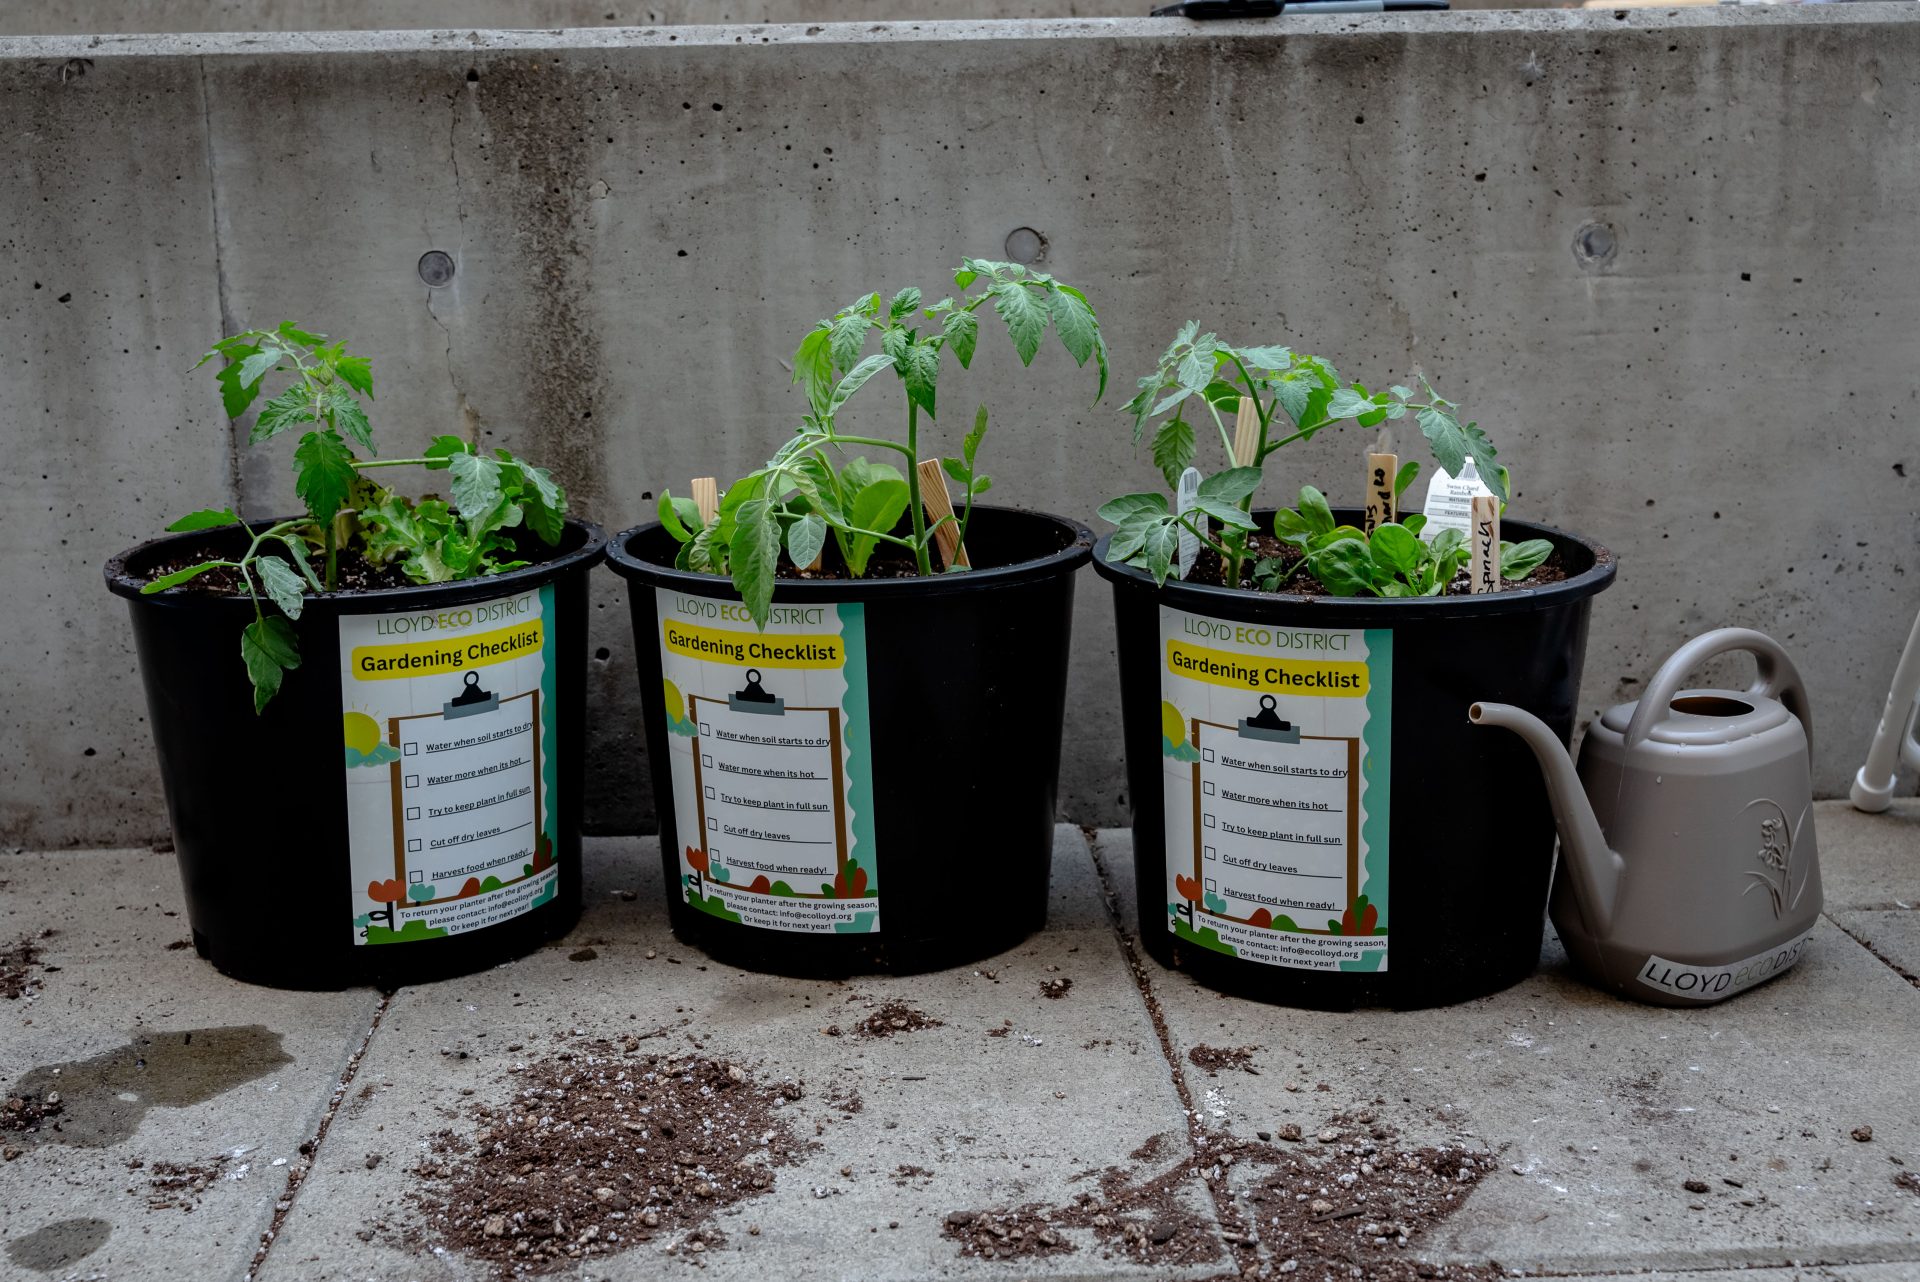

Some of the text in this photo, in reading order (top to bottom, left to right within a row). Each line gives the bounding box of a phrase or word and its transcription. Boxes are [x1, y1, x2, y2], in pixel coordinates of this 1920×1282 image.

[378, 596, 531, 635] LLOYD ECO DISTRICT
[676, 597, 824, 624] LLOYD ECO ISTRICT
[669, 630, 836, 660] Gardening Checklist
[1185, 617, 1350, 650] LLOYD ECO DISTRICT
[361, 630, 538, 671] Gardening Checklist
[1173, 652, 1360, 688] Gardening Checklist
[426, 722, 534, 751] Water when soil starts to dry
[716, 729, 738, 739] Water
[740, 734, 760, 742] when
[762, 735, 777, 743] soil
[778, 737, 803, 745] starts
[816, 738, 830, 747] dry
[427, 776, 452, 784] Water
[455, 770, 476, 779] more
[478, 765, 498, 775] when
[510, 758, 521, 766] hot
[719, 762, 740, 771] Water
[742, 767, 761, 775] more
[1222, 756, 1246, 767] Water
[1248, 762, 1271, 771] when
[1273, 764, 1288, 773] soil
[1291, 767, 1317, 775] starts
[1332, 768, 1348, 777] dry
[428, 808, 442, 816] Try
[456, 802, 474, 811] keep
[476, 797, 496, 808] plant
[506, 790, 518, 798] full
[519, 786, 531, 794] sun
[721, 793, 732, 802] Try
[744, 797, 762, 807] keep
[764, 800, 785, 809] plant
[796, 802, 810, 810] full
[1222, 789, 1246, 800] Water
[1248, 796, 1270, 805] more
[1272, 799, 1296, 808] when
[1299, 801, 1309, 809] its
[431, 827, 500, 847] Cut off dry leaves
[724, 825, 790, 840] Cut off dry leaves
[1222, 822, 1235, 832] Try
[1237, 826, 1245, 834] to
[1248, 828, 1268, 838] keep
[1270, 831, 1293, 841] plant
[1306, 835, 1322, 843] full
[432, 869, 464, 878] Harvest
[486, 857, 505, 866] when
[508, 848, 528, 860] ready!
[727, 856, 827, 874] Harvest food when ready!
[1223, 855, 1297, 873] Cut off dry leaves
[413, 908, 438, 917] return
[440, 904, 458, 914] your
[460, 898, 486, 910] planter
[488, 893, 503, 901] after
[505, 888, 516, 897] the
[517, 879, 539, 893] growing
[429, 887, 543, 926] please contact: info@ecolloyd.org
[706, 884, 714, 892] To
[714, 888, 732, 898] return
[734, 893, 749, 903] your
[751, 896, 776, 908] planter
[798, 901, 812, 909] the
[814, 902, 845, 910] growing
[1224, 887, 1334, 910] Harvest food when ready!
[462, 920, 480, 930] keep
[488, 914, 498, 922] for
[499, 910, 513, 920] next
[515, 903, 529, 914] year!
[727, 901, 851, 921] please contact: info@ecolloyd.org
[754, 917, 771, 927] keep
[772, 919, 778, 927] it
[780, 920, 790, 928] for
[1198, 914, 1206, 923] To
[1207, 918, 1229, 930] return
[1231, 925, 1247, 935] your
[1249, 929, 1277, 940] planter
[1280, 935, 1300, 943] after
[1318, 938, 1352, 948] growing
[1221, 934, 1358, 958] please contact: info@ecolloyd.org
[1251, 951, 1270, 961] keep
[1272, 954, 1278, 962] it
[1279, 955, 1291, 964] for
[1294, 957, 1311, 965] next
[1313, 960, 1335, 968] year!
[1645, 964, 1732, 993] LLOYD
